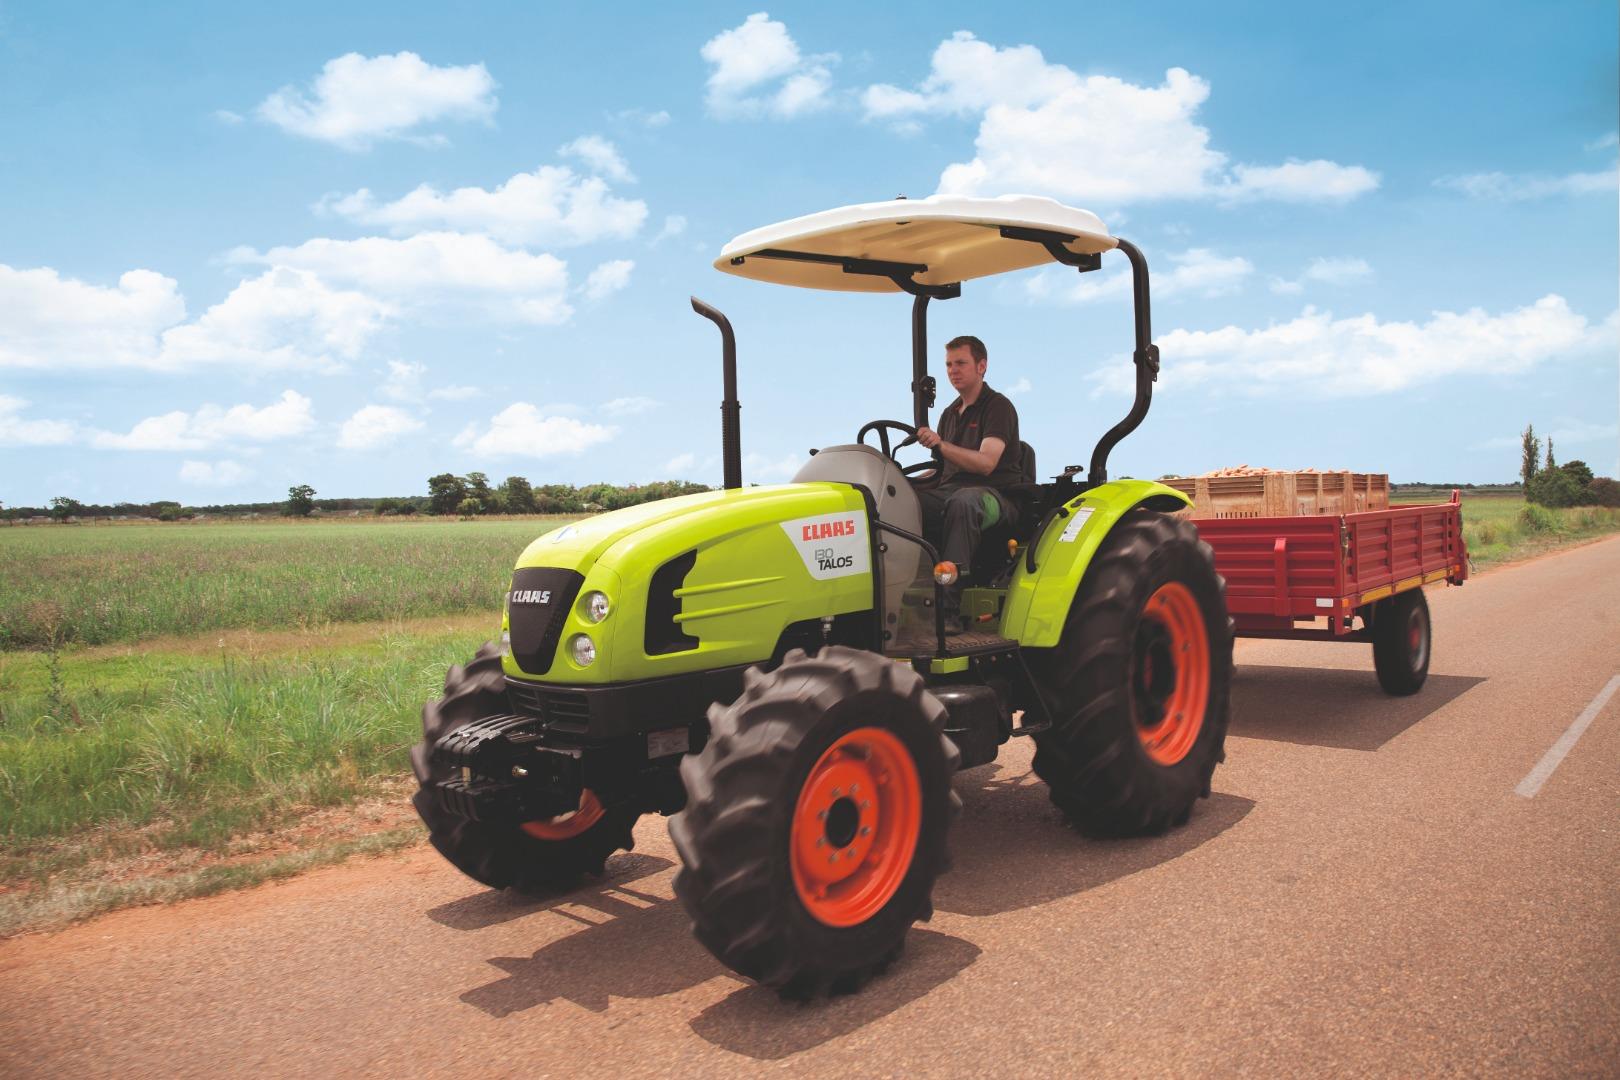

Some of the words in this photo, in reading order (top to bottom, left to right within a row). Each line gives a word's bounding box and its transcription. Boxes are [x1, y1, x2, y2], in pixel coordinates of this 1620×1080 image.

[803, 520, 855, 541] CLAAS
[814, 548, 834, 560] 130
[818, 556, 853, 570] TALOS
[512, 591, 551, 603] CLAAS
